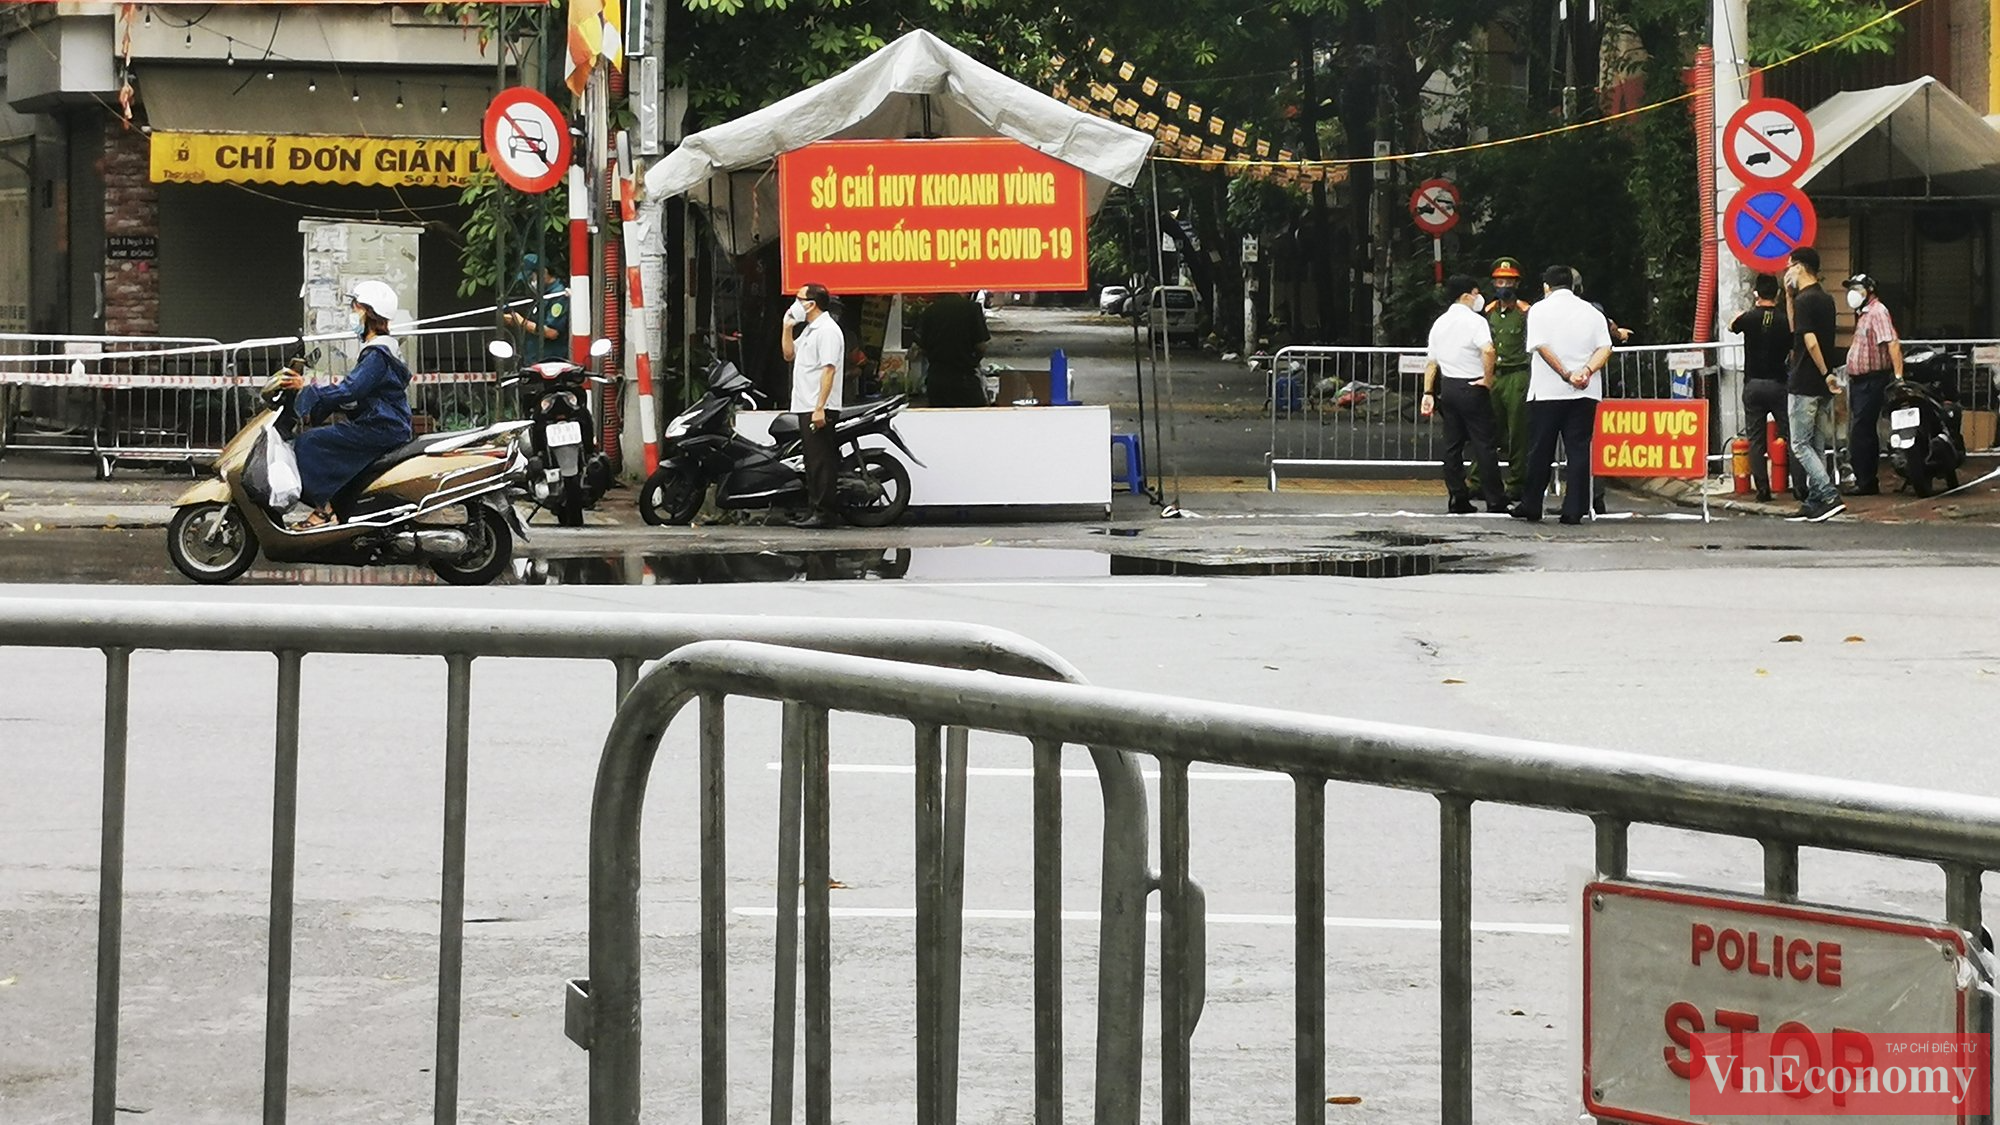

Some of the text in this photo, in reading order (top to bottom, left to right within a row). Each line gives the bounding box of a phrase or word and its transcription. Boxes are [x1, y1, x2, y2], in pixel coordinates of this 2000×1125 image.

[215, 137, 277, 170] CHỈ
[288, 144, 362, 172] ĐƠN
[374, 140, 456, 173] GIẢN
[810, 164, 1056, 209] SỞ CHỈ HUY KHOANH VÙNG
[796, 218, 1073, 268] PHÒNG CHỐNG DỊCH COVID-19
[1602, 409, 1698, 440] KHU VỰC
[1603, 440, 1697, 469] CÁCH LY
[1690, 922, 1843, 988] POLICE
[1663, 1001, 1876, 1108] STOP
